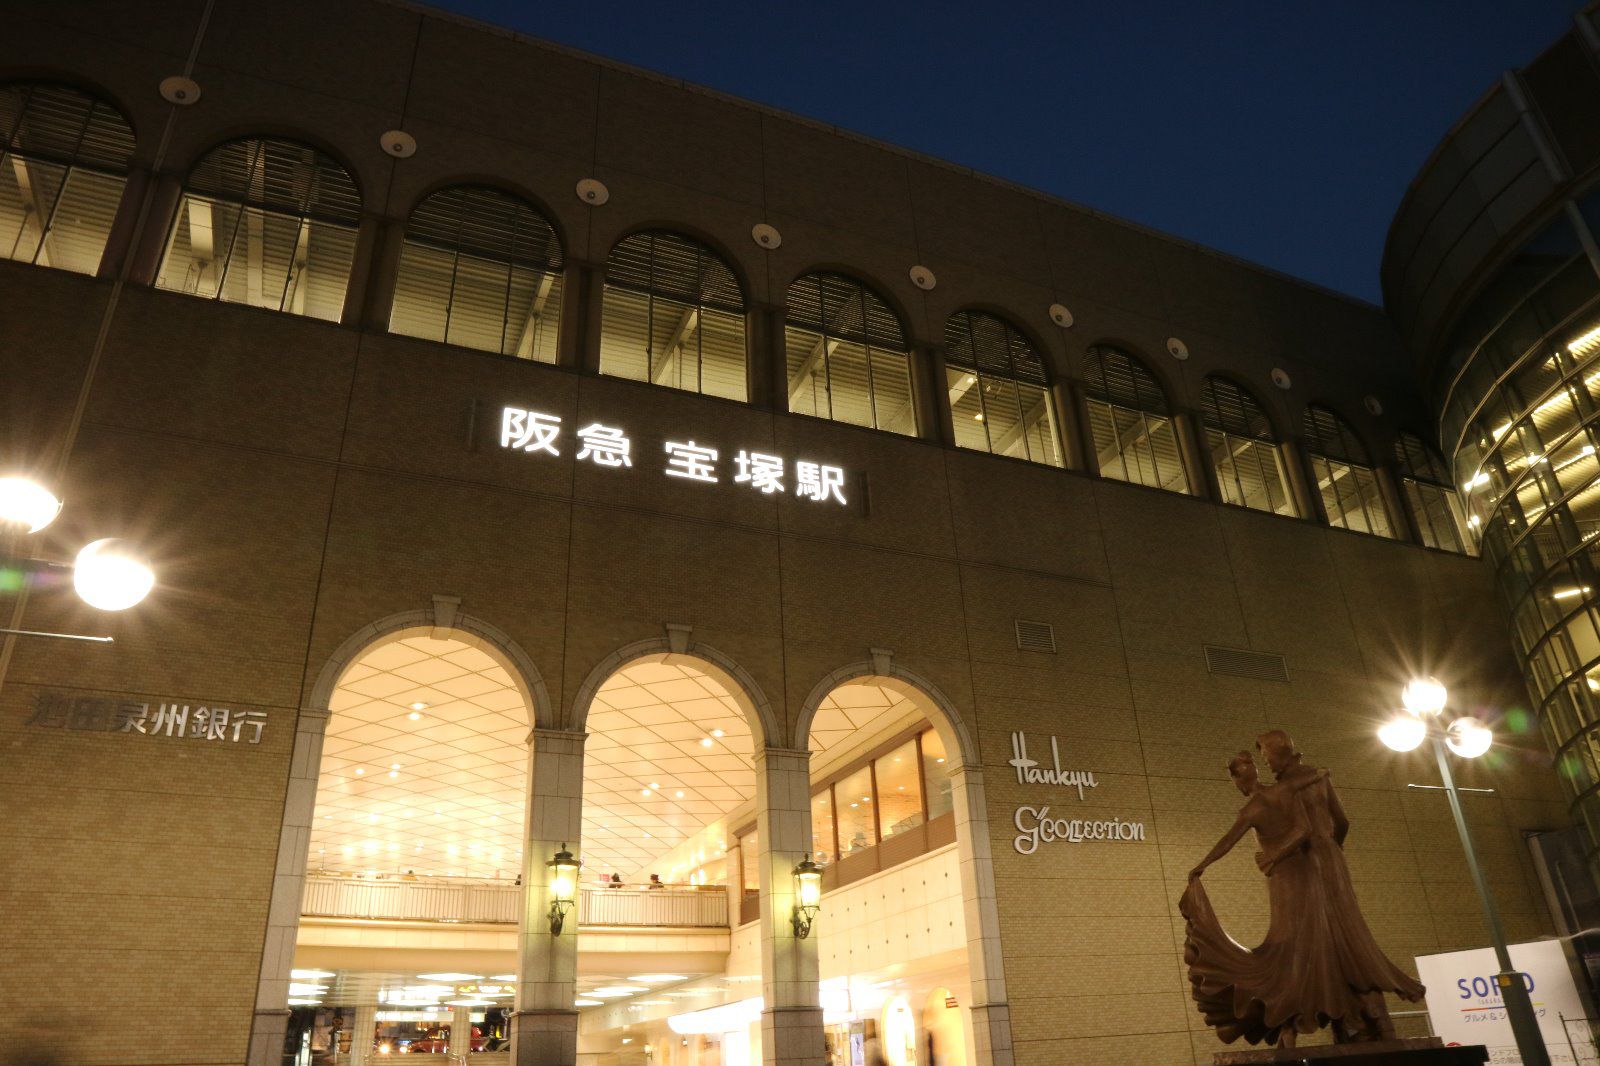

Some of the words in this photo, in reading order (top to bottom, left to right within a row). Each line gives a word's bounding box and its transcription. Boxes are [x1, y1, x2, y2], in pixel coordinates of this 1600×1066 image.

[501, 406, 633, 467] 阪急
[665, 440, 847, 505] 宝塚駅
[1009, 730, 1099, 800] Hankyu
[1458, 972, 1535, 999] SOO
